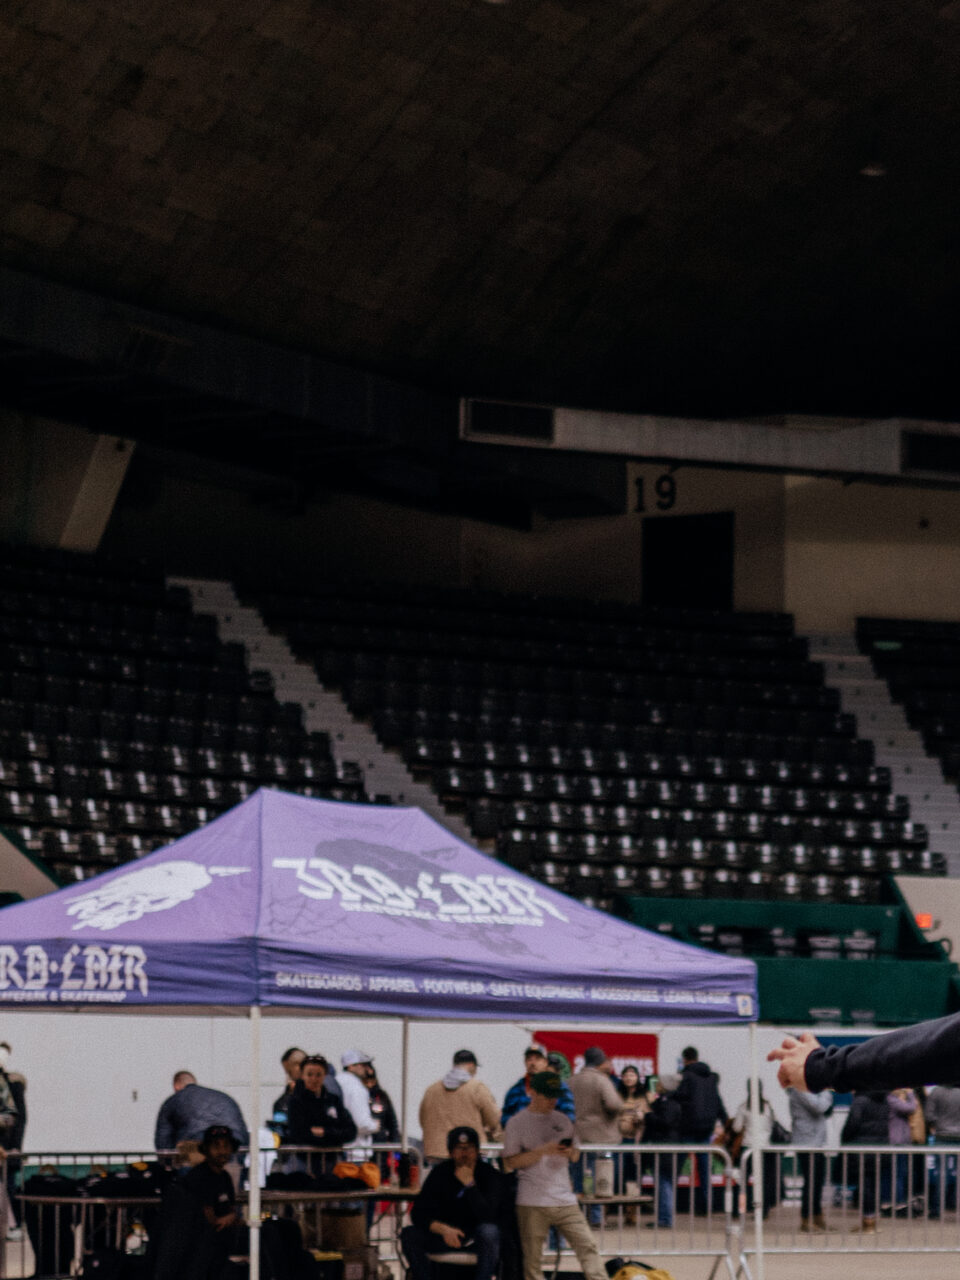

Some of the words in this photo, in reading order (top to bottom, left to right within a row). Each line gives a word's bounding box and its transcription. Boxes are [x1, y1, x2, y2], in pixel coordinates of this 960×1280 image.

[633, 475, 677, 511] 19
[275, 972, 362, 991] SKATEBOARDS
[369, 976, 418, 993] APPAREL
[424, 979, 484, 995] FOOTWEAR
